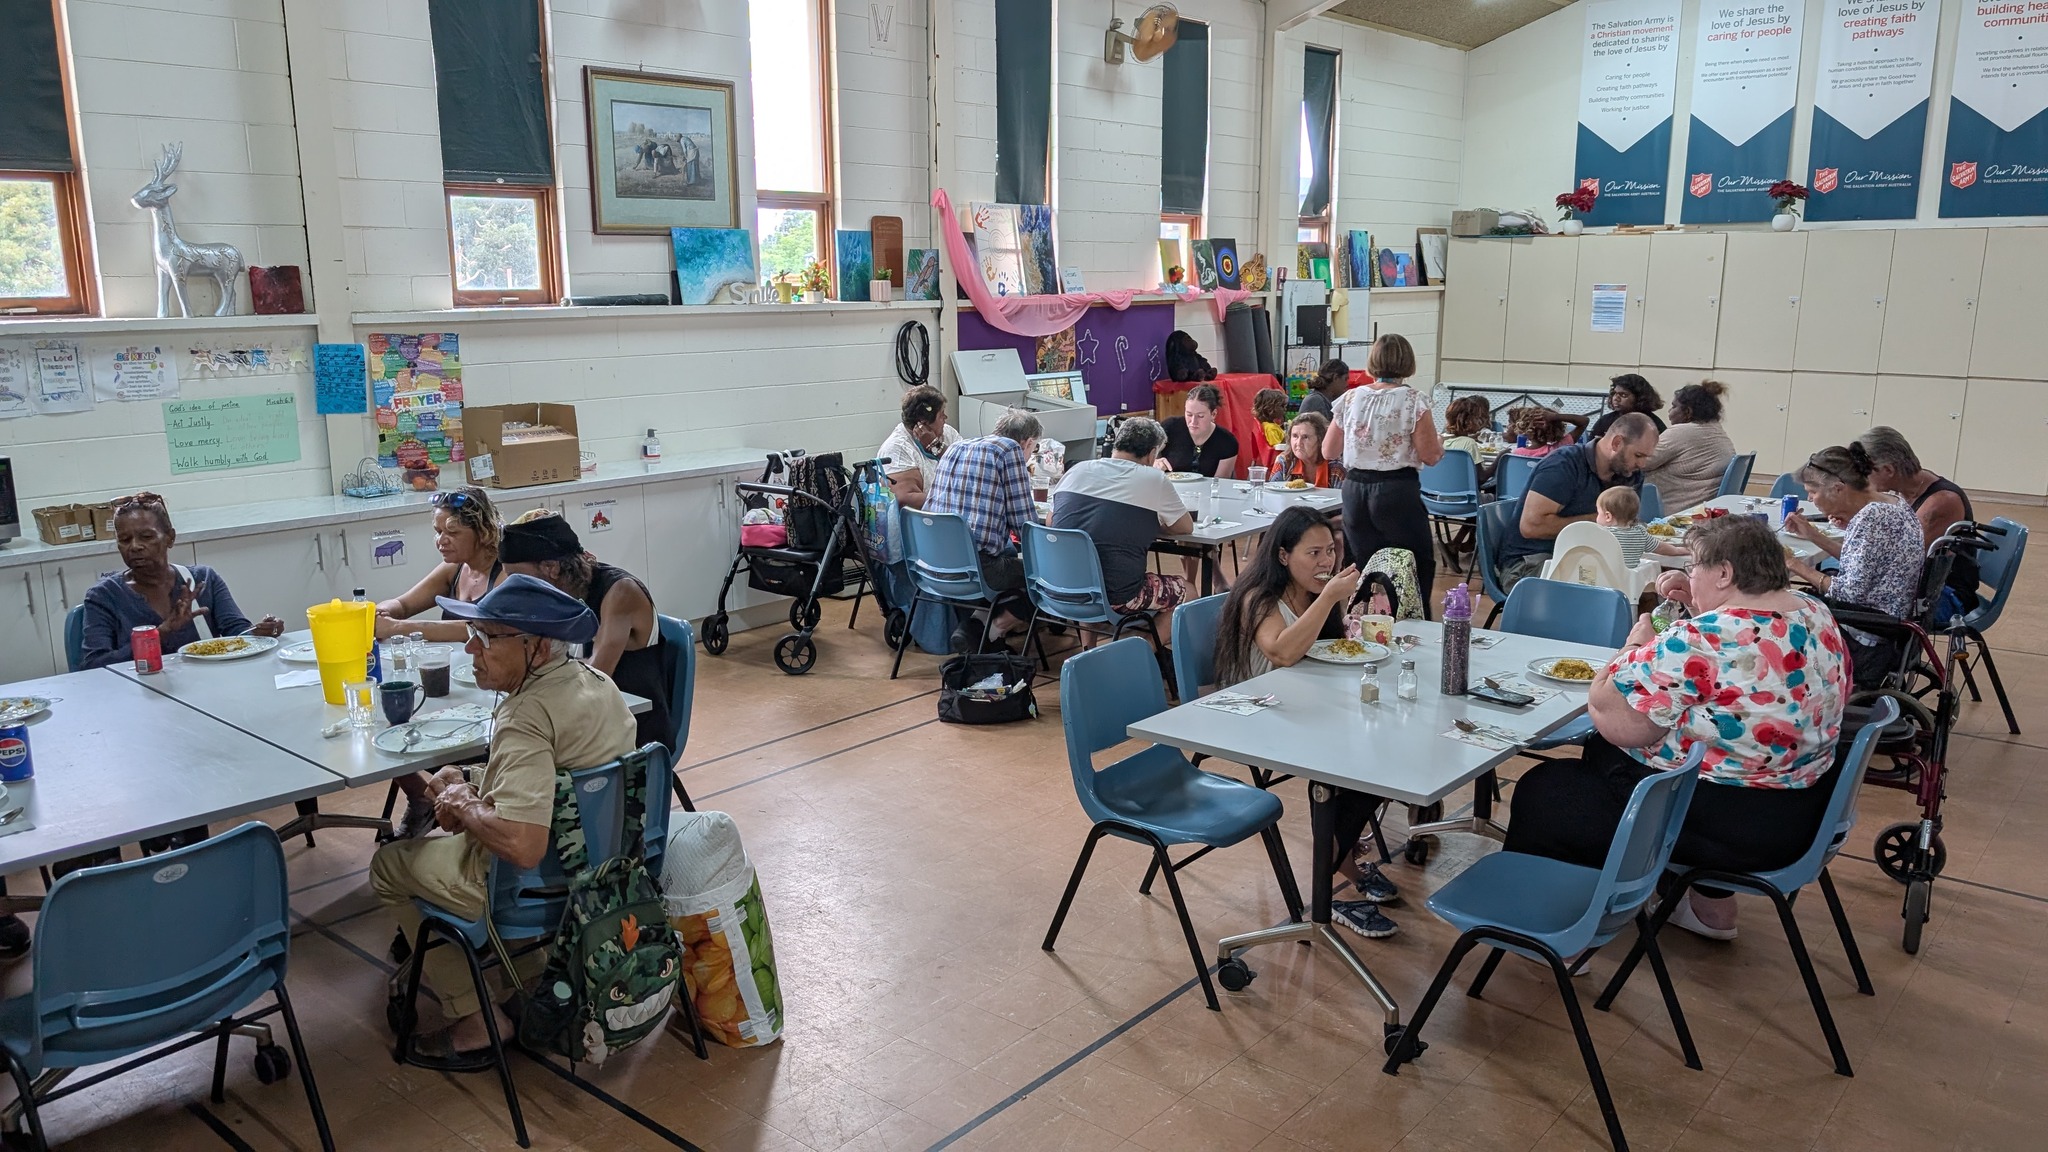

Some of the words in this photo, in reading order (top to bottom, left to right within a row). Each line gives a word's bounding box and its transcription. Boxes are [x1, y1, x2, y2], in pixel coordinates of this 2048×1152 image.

[1719, 9, 1734, 18] We
[1737, 7, 1765, 17] share
[1767, 4, 1785, 13] the
[1838, 7, 1859, 17] love
[1863, 5, 1874, 14] of
[1876, 3, 1908, 13] Jesus
[1911, 1, 1925, 11] by
[1977, 4, 2025, 15] building
[1608, 19, 1642, 29] Salvation
[1644, 17, 1665, 25] Army
[1711, 21, 1731, 30] love
[1733, 18, 1744, 27] of
[1746, 16, 1775, 26] Jesus
[1777, 14, 1791, 25] by
[1843, 16, 1888, 28] creating
[1891, 13, 1916, 24] faith
[1597, 29, 1631, 39] Christian
[1633, 24, 1674, 35] movement
[1707, 31, 1738, 41] caring
[1740, 29, 1755, 38] for
[1757, 25, 1792, 38] people
[1852, 27, 1904, 41] pathways
[1592, 38, 1630, 48] dedicated
[1641, 35, 1670, 43] sharing
[1625, 46, 1632, 54] of
[1634, 45, 1656, 53] Jesus
[1658, 43, 1668, 52] by
[1844, 170, 1869, 183] Our
[1869, 170, 1912, 181] Mission
[1984, 165, 2011, 178] Our
[1604, 181, 1625, 192] Our
[1624, 181, 1660, 190] Mission
[1717, 176, 1740, 188] Our
[1740, 176, 1780, 185] Mission
[730, 280, 779, 305] Smile
[208, 401, 215, 410] of
[394, 392, 443, 409] PRAYER
[0, 747, 25, 756] EPSI
